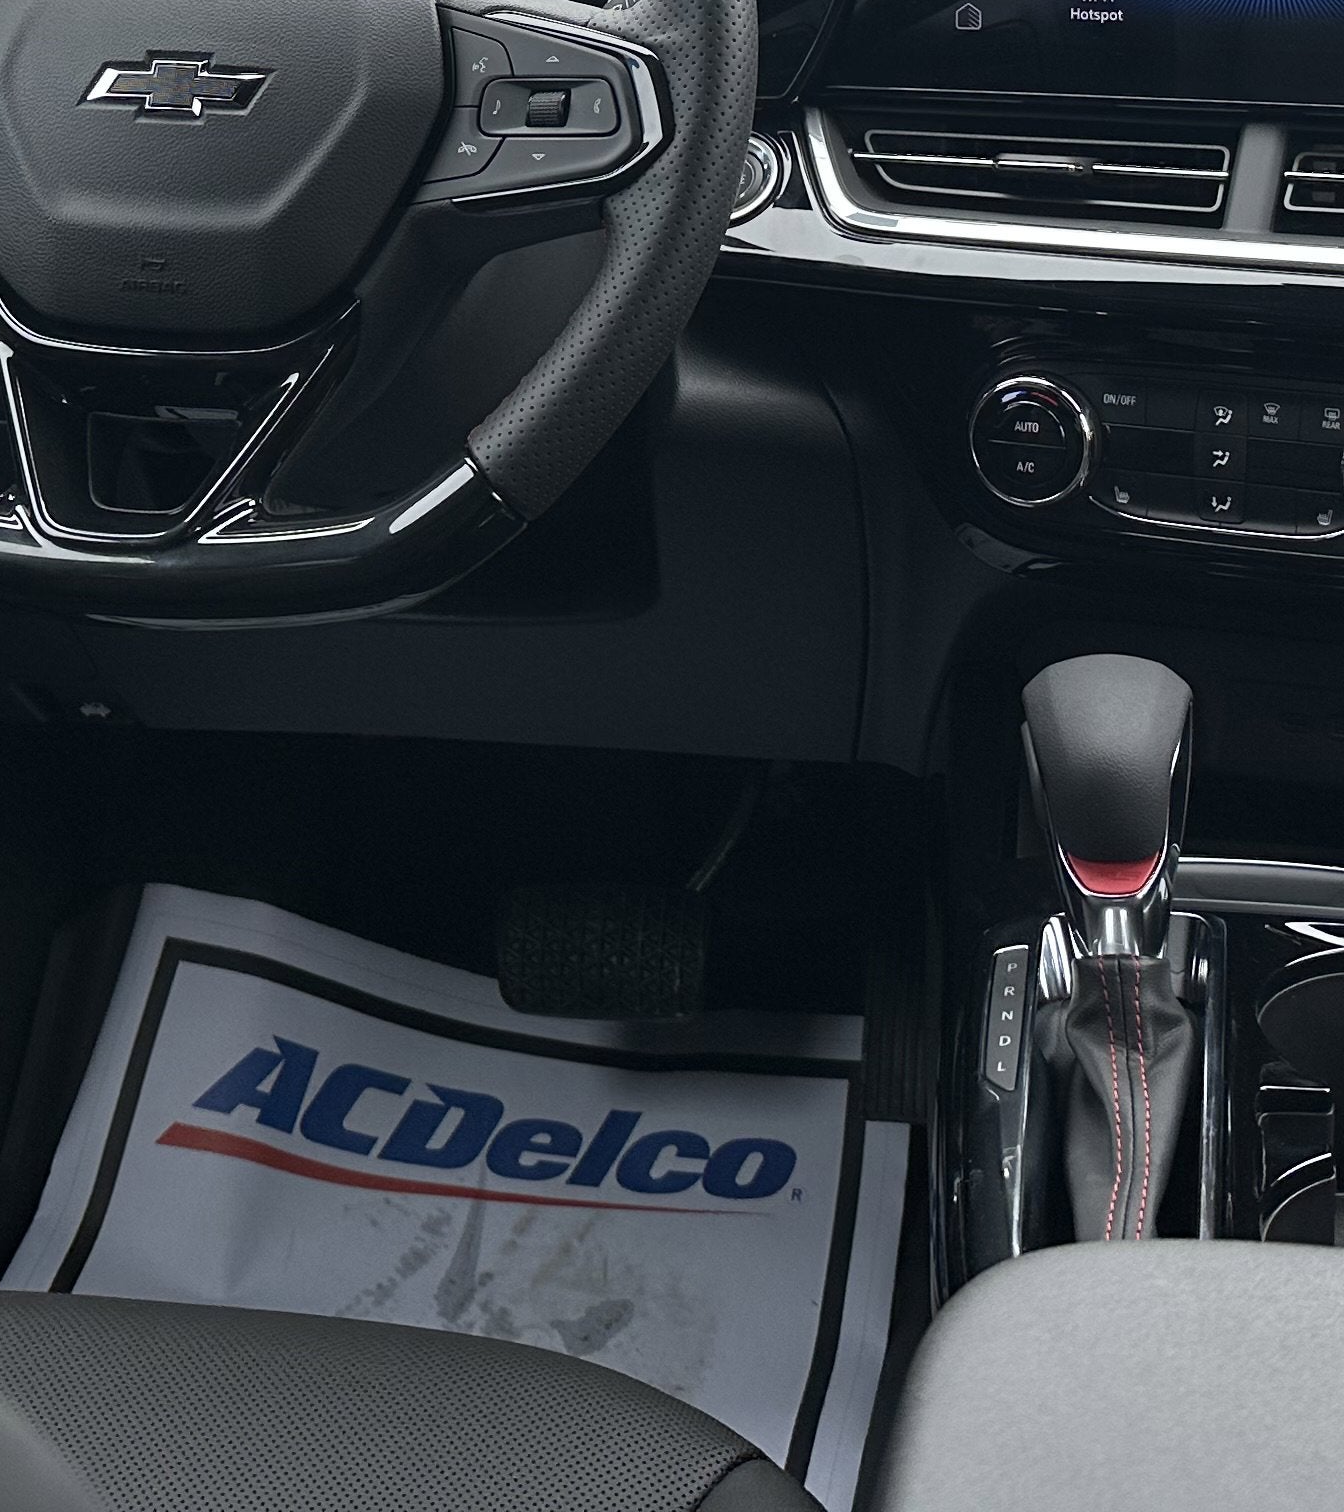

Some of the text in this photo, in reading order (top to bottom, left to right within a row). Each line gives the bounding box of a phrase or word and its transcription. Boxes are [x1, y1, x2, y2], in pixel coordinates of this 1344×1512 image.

[1070, 8, 1124, 23] Hotspot
[1103, 393, 1136, 405] ON/OFF
[1262, 414, 1279, 424] MAX
[1321, 420, 1341, 430] REAR
[1014, 421, 1040, 433] AUTO
[1016, 461, 1035, 473] A/C
[1007, 961, 1018, 974] P
[1003, 985, 1015, 997] R
[1001, 1010, 1014, 1022] N
[998, 1035, 1011, 1047] D
[997, 1061, 1006, 1072] L
[192, 1035, 798, 1201] ACDelco
